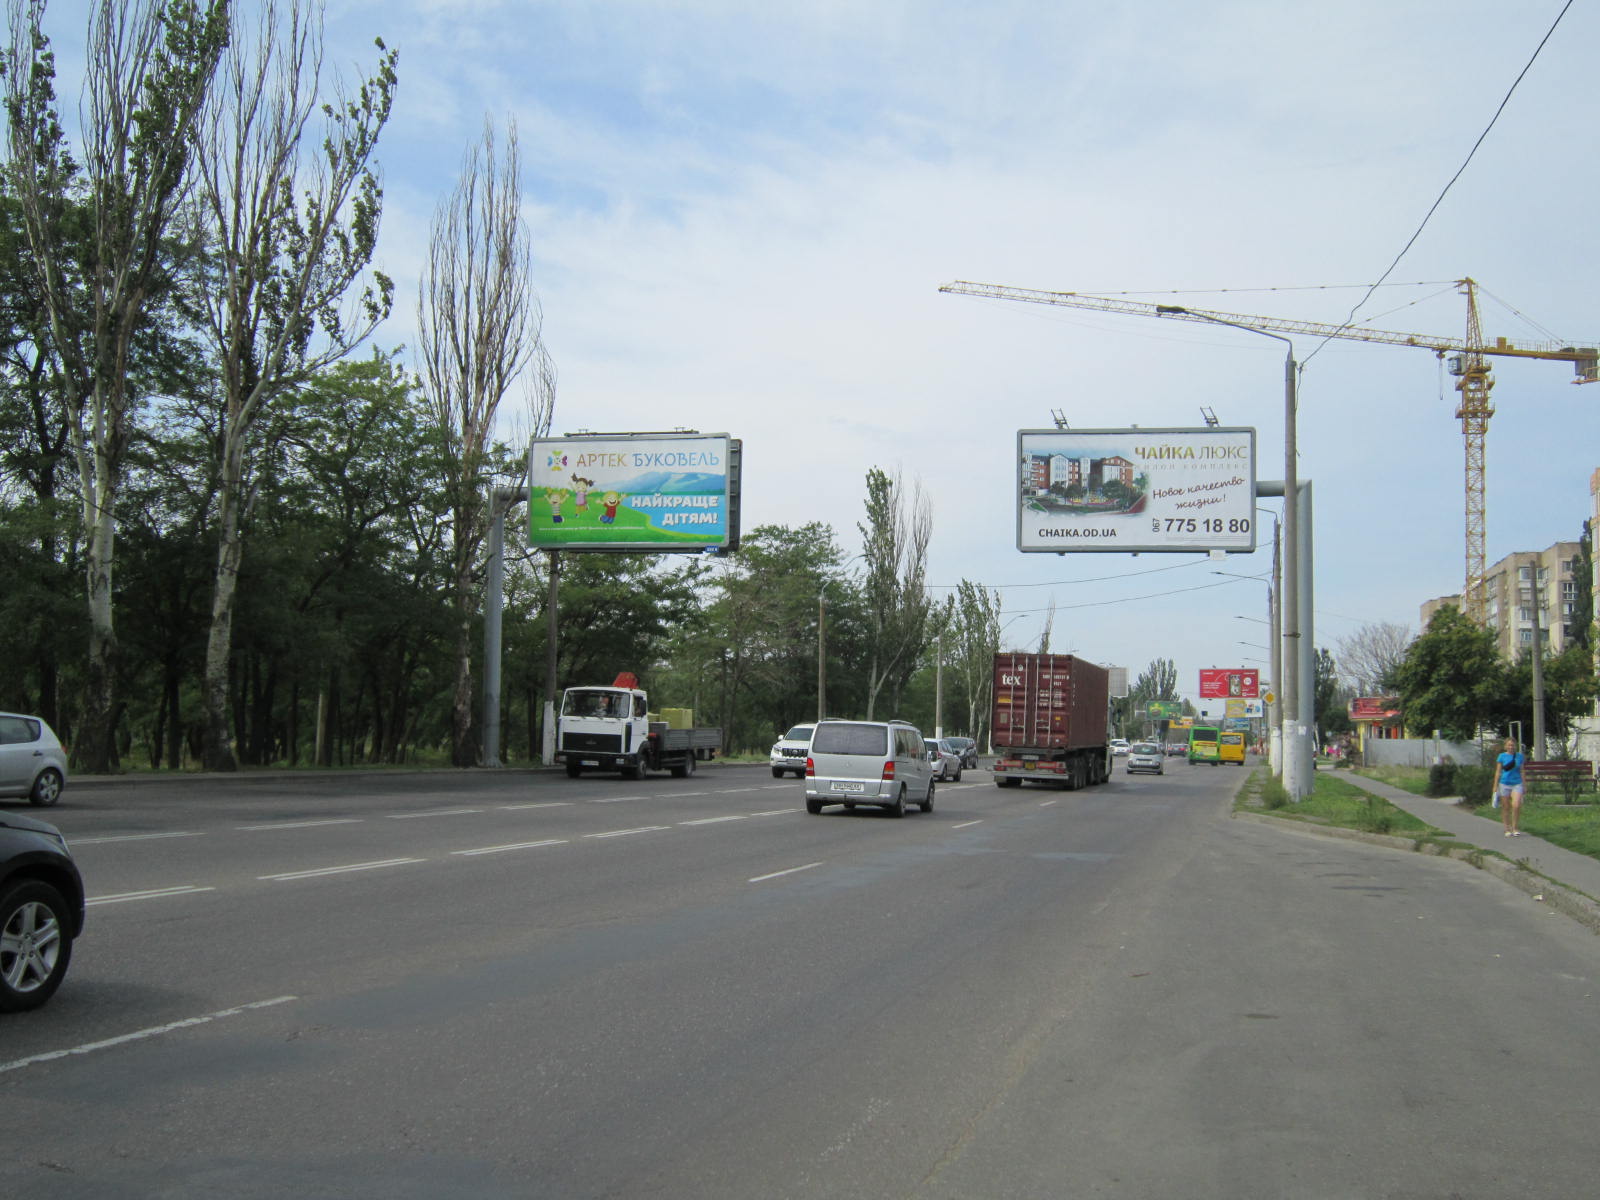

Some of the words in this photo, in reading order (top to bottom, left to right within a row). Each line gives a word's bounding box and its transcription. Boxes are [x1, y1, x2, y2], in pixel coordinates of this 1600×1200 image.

[576, 453, 628, 467] АРТЕК
[632, 452, 720, 467] БУКОВЕЛЬ
[1135, 444, 1195, 460] ЧАЙКА
[1198, 445, 1248, 460] ЛЮКС
[1152, 486, 1185, 500] Новое
[1187, 476, 1246, 494] качество
[631, 493, 719, 509] НАЙКРАЩЕ
[1174, 494, 1227, 512] жизни!
[661, 512, 719, 526] ДІТЯМ!
[1152, 518, 1161, 533] 067
[1165, 518, 1197, 533] 775
[1202, 518, 1223, 533] 18
[1228, 518, 1250, 533] 80
[1038, 528, 1117, 538] CHAIKA.OD.UA
[1001, 673, 1022, 686] tex
